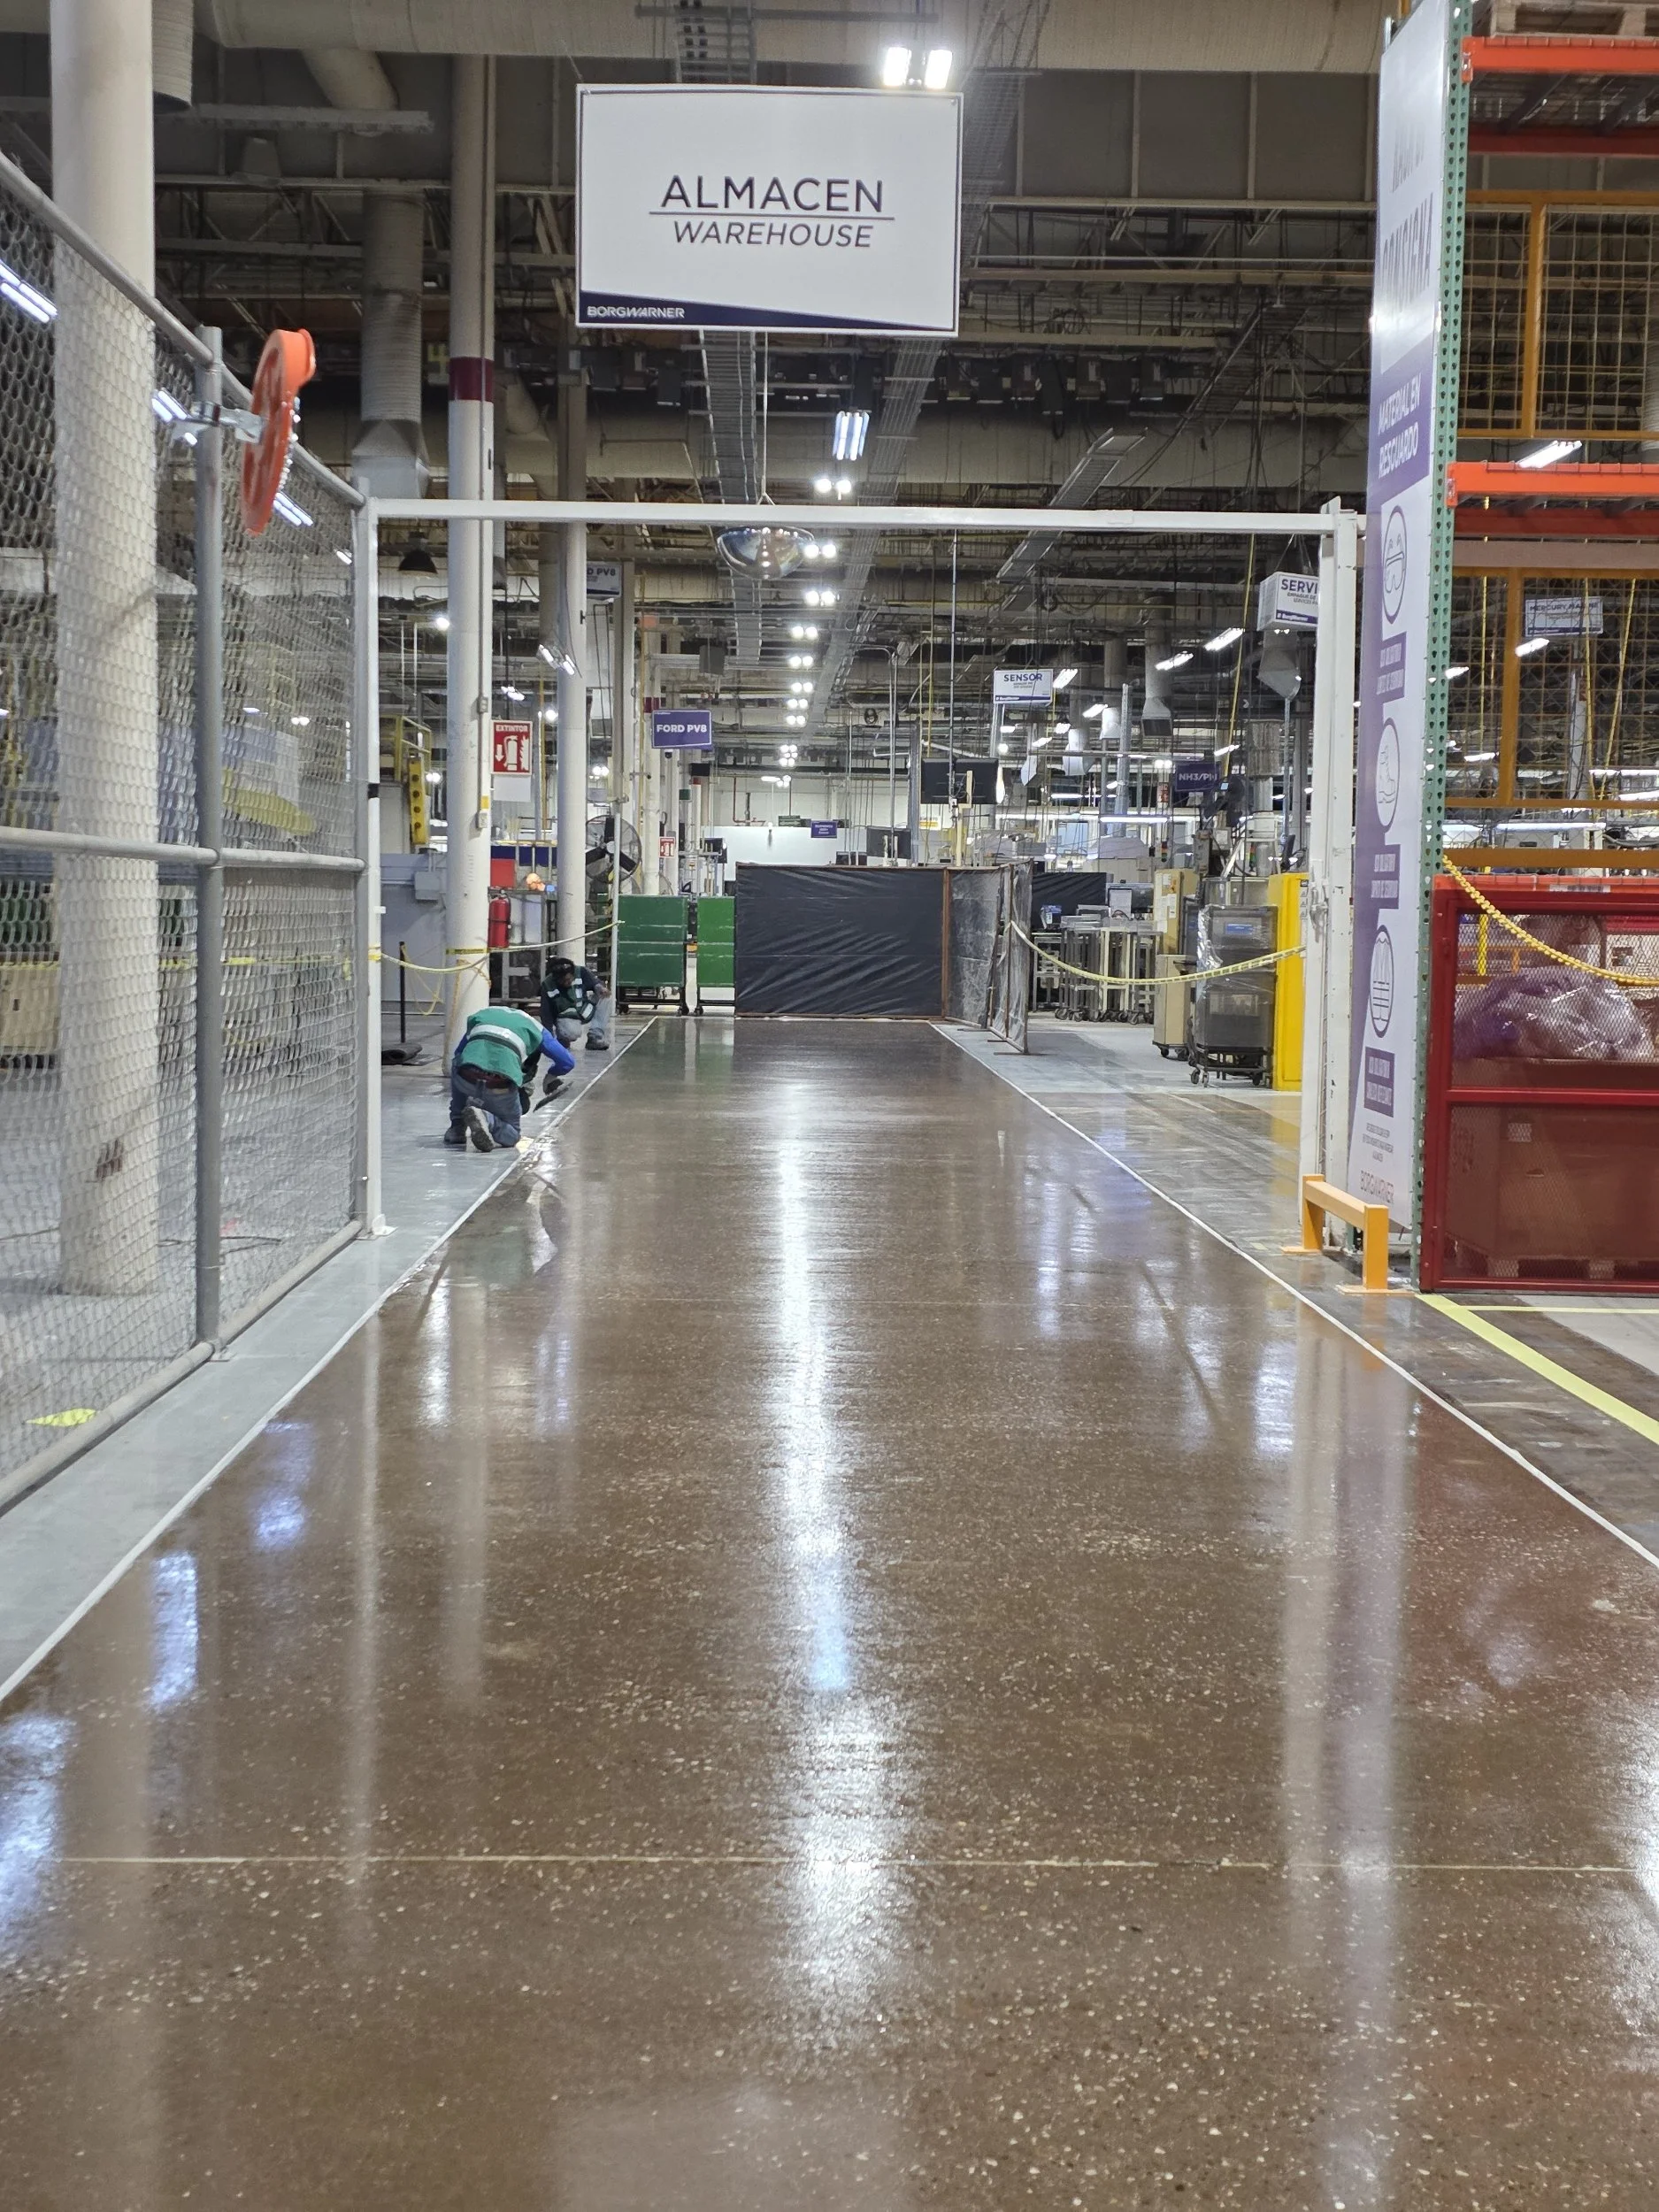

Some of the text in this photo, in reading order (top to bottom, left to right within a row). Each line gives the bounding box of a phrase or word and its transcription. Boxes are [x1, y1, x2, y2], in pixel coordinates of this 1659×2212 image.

[661, 174, 883, 212] ALMACEN
[673, 220, 874, 248] WAREHOUSE
[587, 305, 686, 319] BORGWARNER
[1378, 372, 1422, 436] MATERIAL EN
[1378, 421, 1419, 479] RESGUARDO
[596, 567, 616, 576] PV8
[1281, 578, 1318, 594] SERVI
[657, 724, 708, 733] FORD PV8
